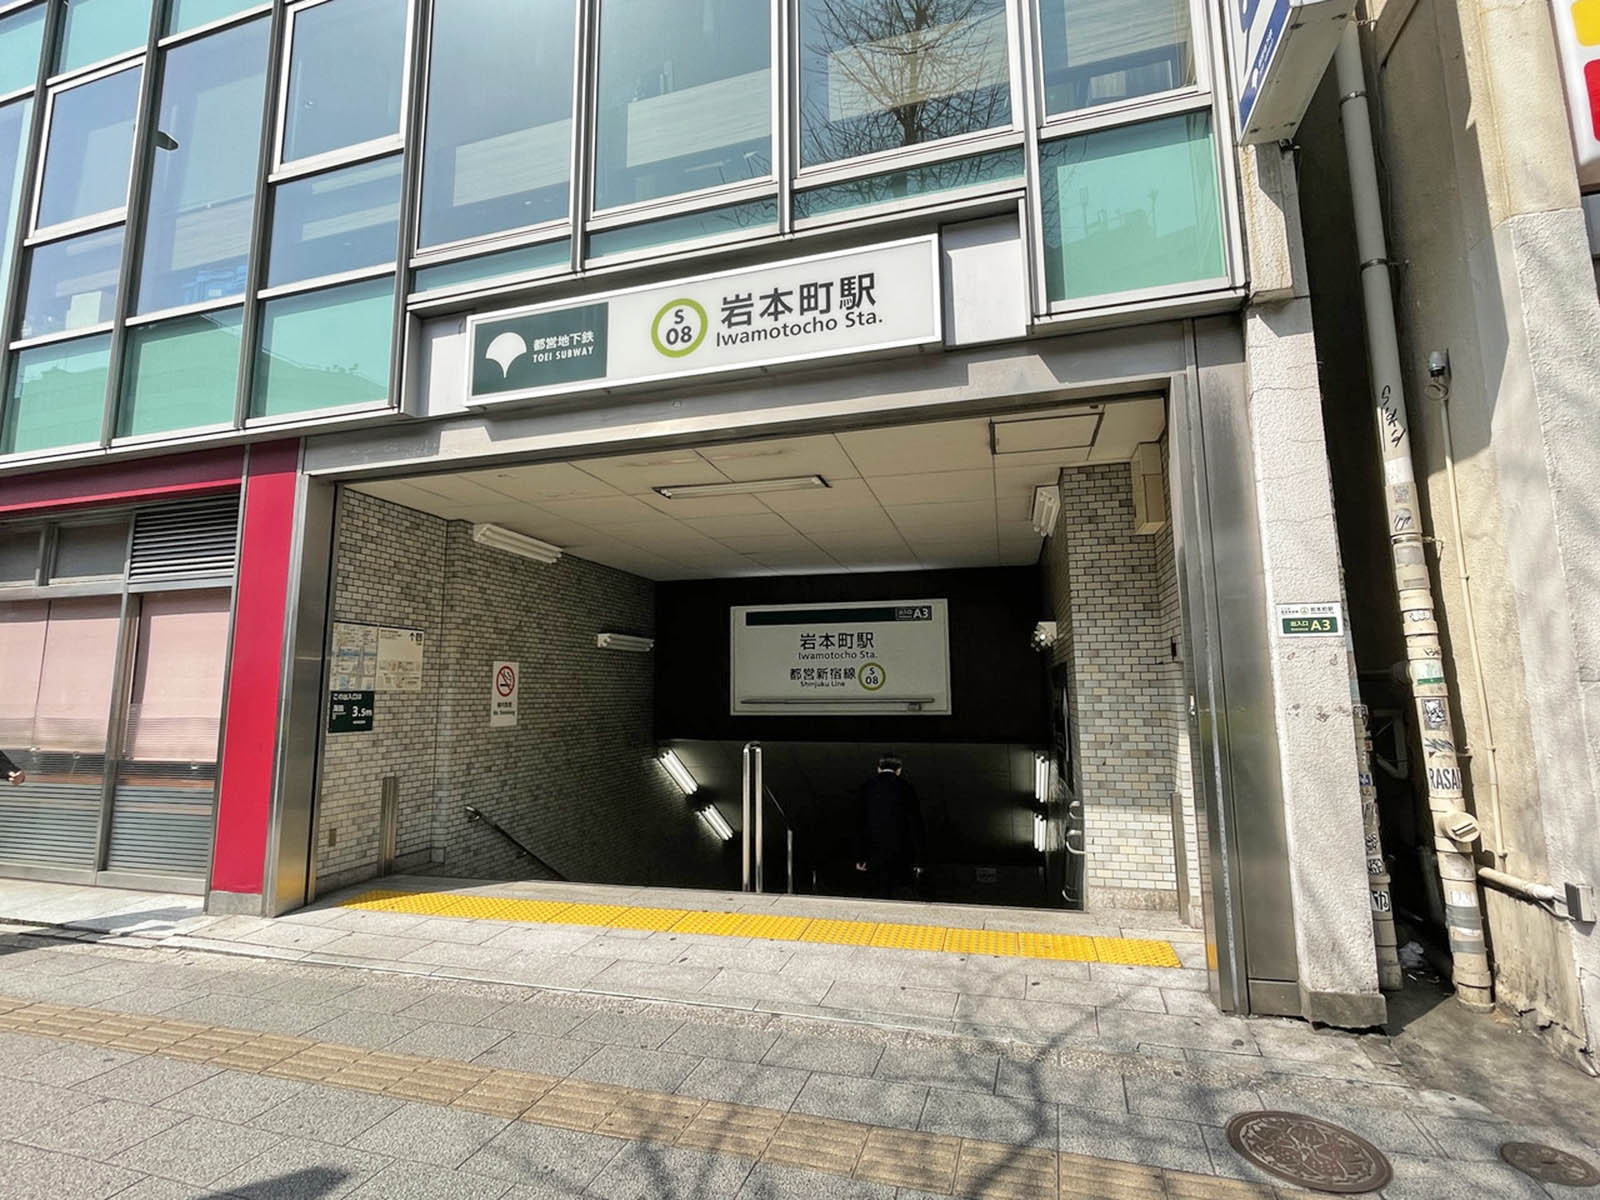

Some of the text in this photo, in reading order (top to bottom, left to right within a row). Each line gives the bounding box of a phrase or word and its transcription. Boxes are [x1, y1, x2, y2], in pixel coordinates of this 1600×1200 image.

[721, 272, 876, 329] 岩本町駅
[674, 309, 684, 324] S
[666, 326, 692, 345] 08
[716, 311, 883, 347] Iwamotocho Sta.
[533, 330, 594, 351] 都営地下鉄
[533, 345, 594, 363] TOEI SUBWAY
[913, 607, 929, 618] A3
[1310, 619, 1331, 631] A3
[800, 632, 874, 650] 岩本町駅
[798, 650, 878, 660] Iwamotocho Sta.
[790, 667, 856, 681] 都営新宿線
[869, 667, 875, 675] S
[865, 676, 879, 685] 08
[352, 705, 373, 717] 3.5m
